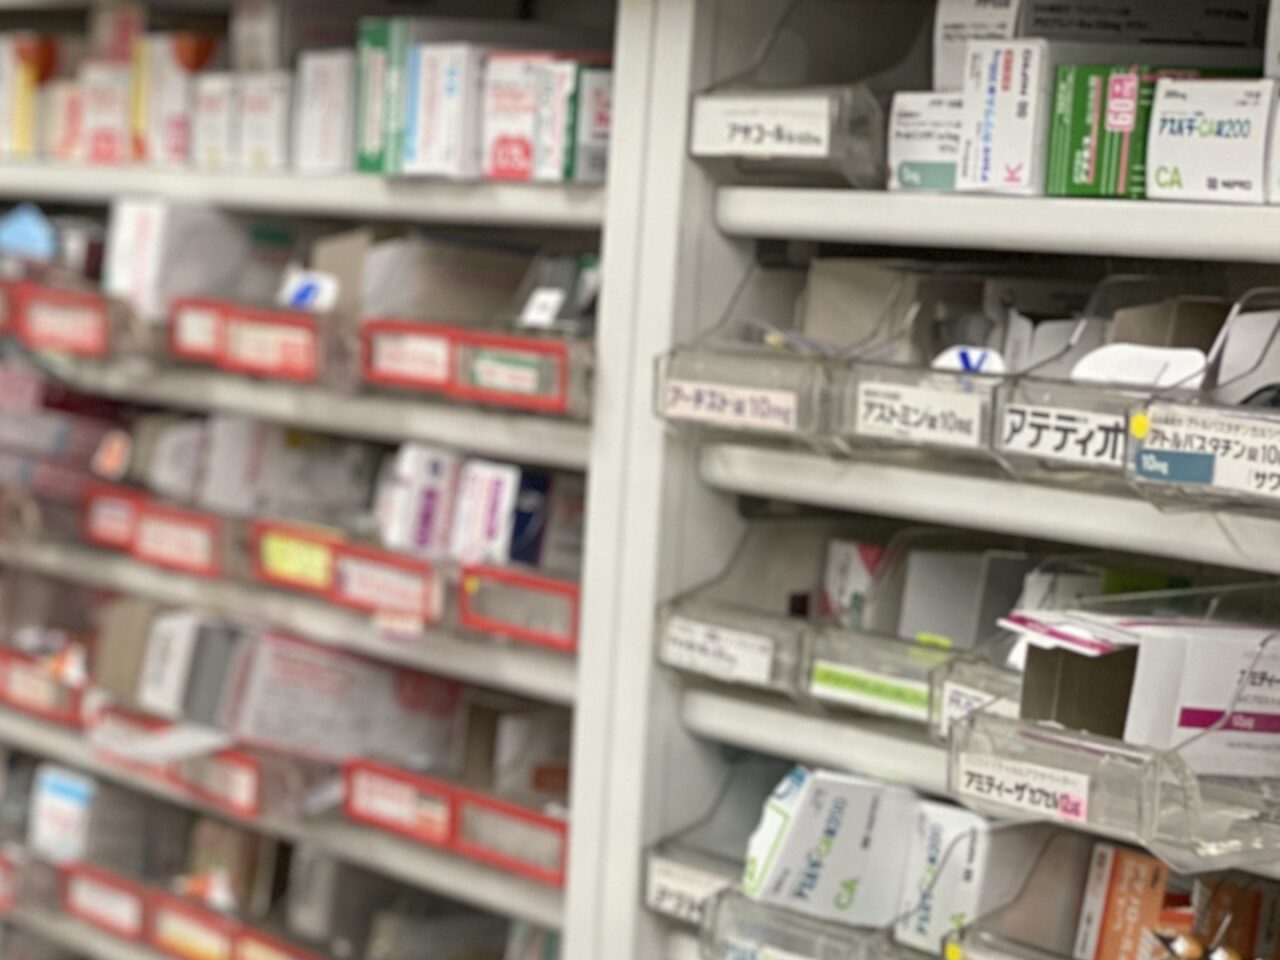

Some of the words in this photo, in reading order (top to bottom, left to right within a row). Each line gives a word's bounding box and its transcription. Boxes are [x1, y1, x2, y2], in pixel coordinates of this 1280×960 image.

[1003, 163, 1024, 183] K
[1155, 165, 1184, 190] CA
[1003, 407, 1126, 460] アテディオ
[1149, 428, 1280, 467] アトルバスタチン錠10
